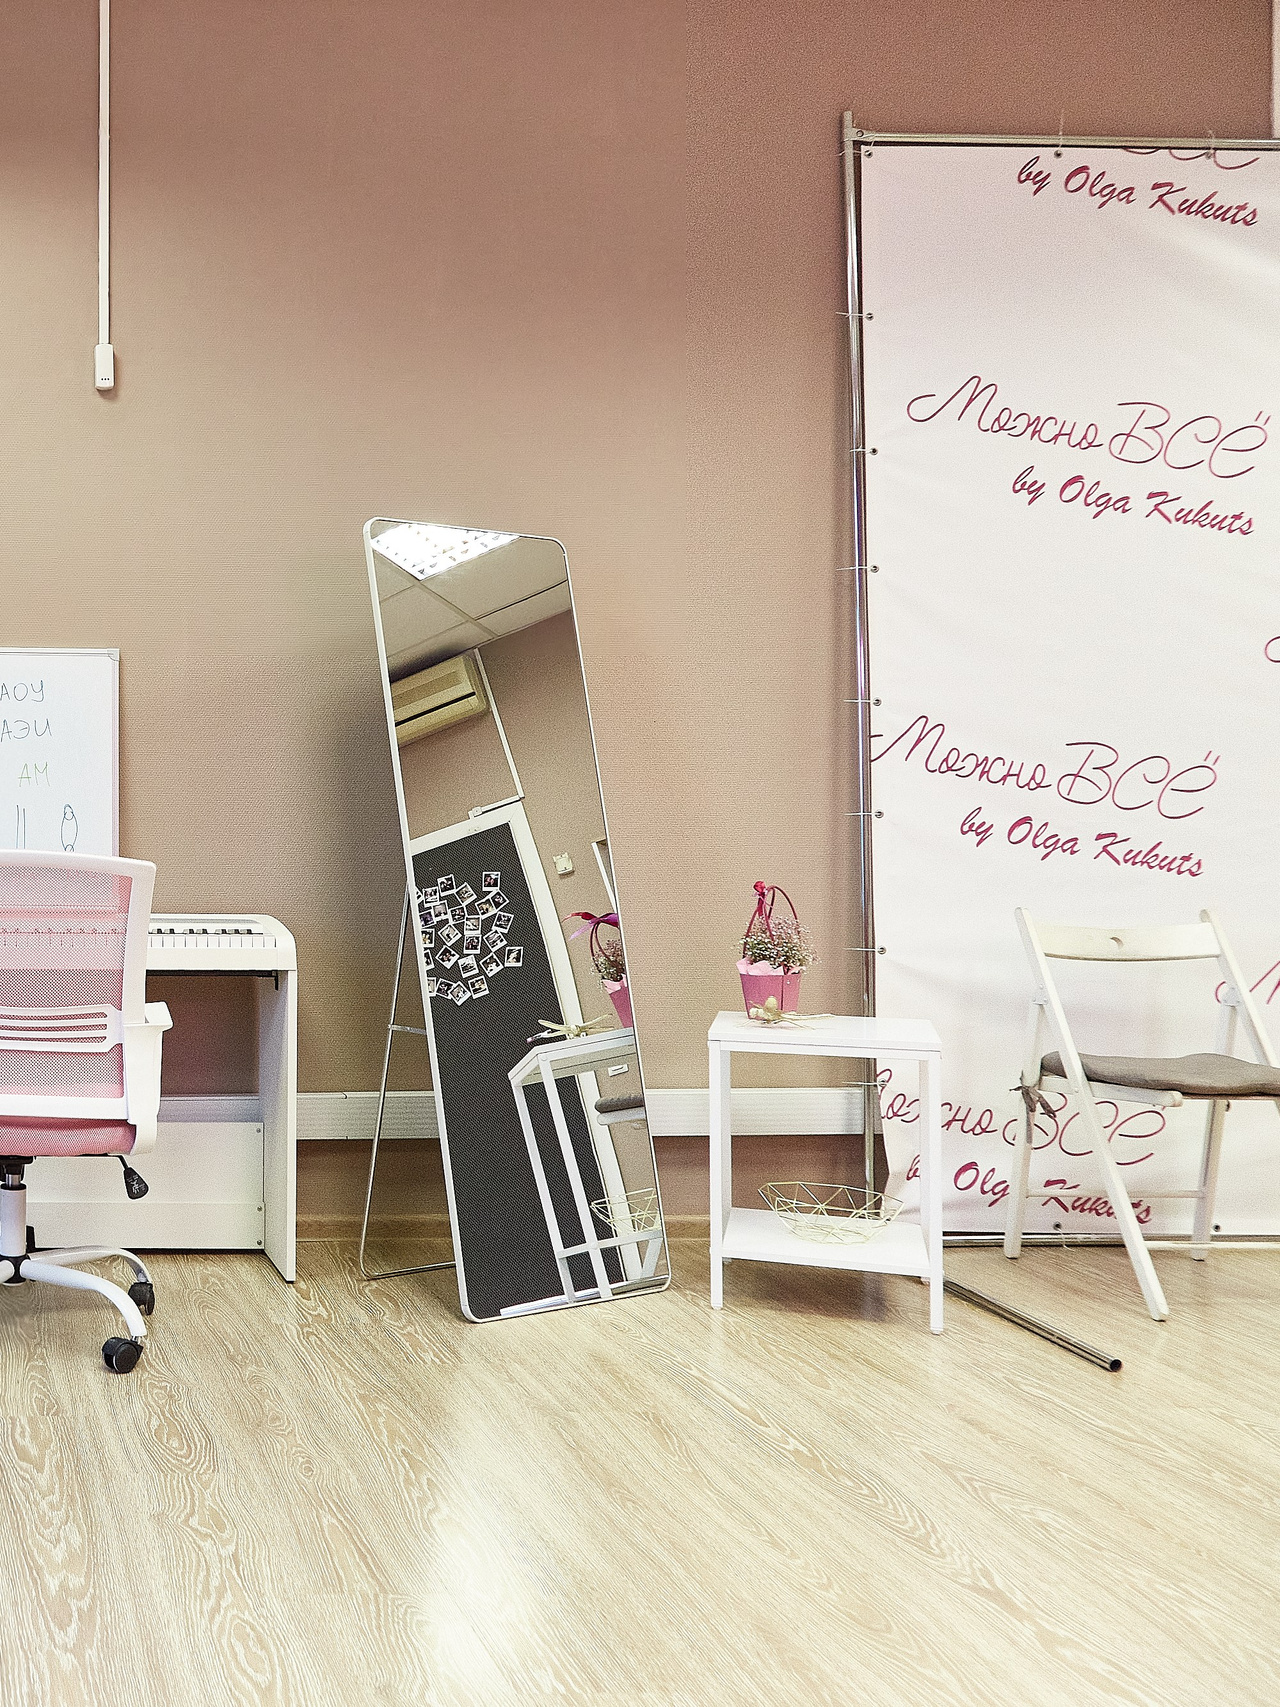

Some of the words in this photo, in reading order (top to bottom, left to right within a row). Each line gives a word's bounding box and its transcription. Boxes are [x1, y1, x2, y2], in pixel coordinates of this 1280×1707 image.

[1017, 155, 1052, 196] by
[1063, 165, 1137, 209] Olga
[1149, 181, 1259, 227] Kukuts
[906, 375, 1104, 451] Можно
[1011, 465, 1046, 506] by
[1058, 474, 1132, 520] Olga
[1145, 491, 1255, 536] Kukuts
[959, 806, 994, 848] by
[1006, 816, 1080, 861] Olga
[1093, 832, 1204, 878] Kukuts
[953, 1161, 1011, 1208] Olg
